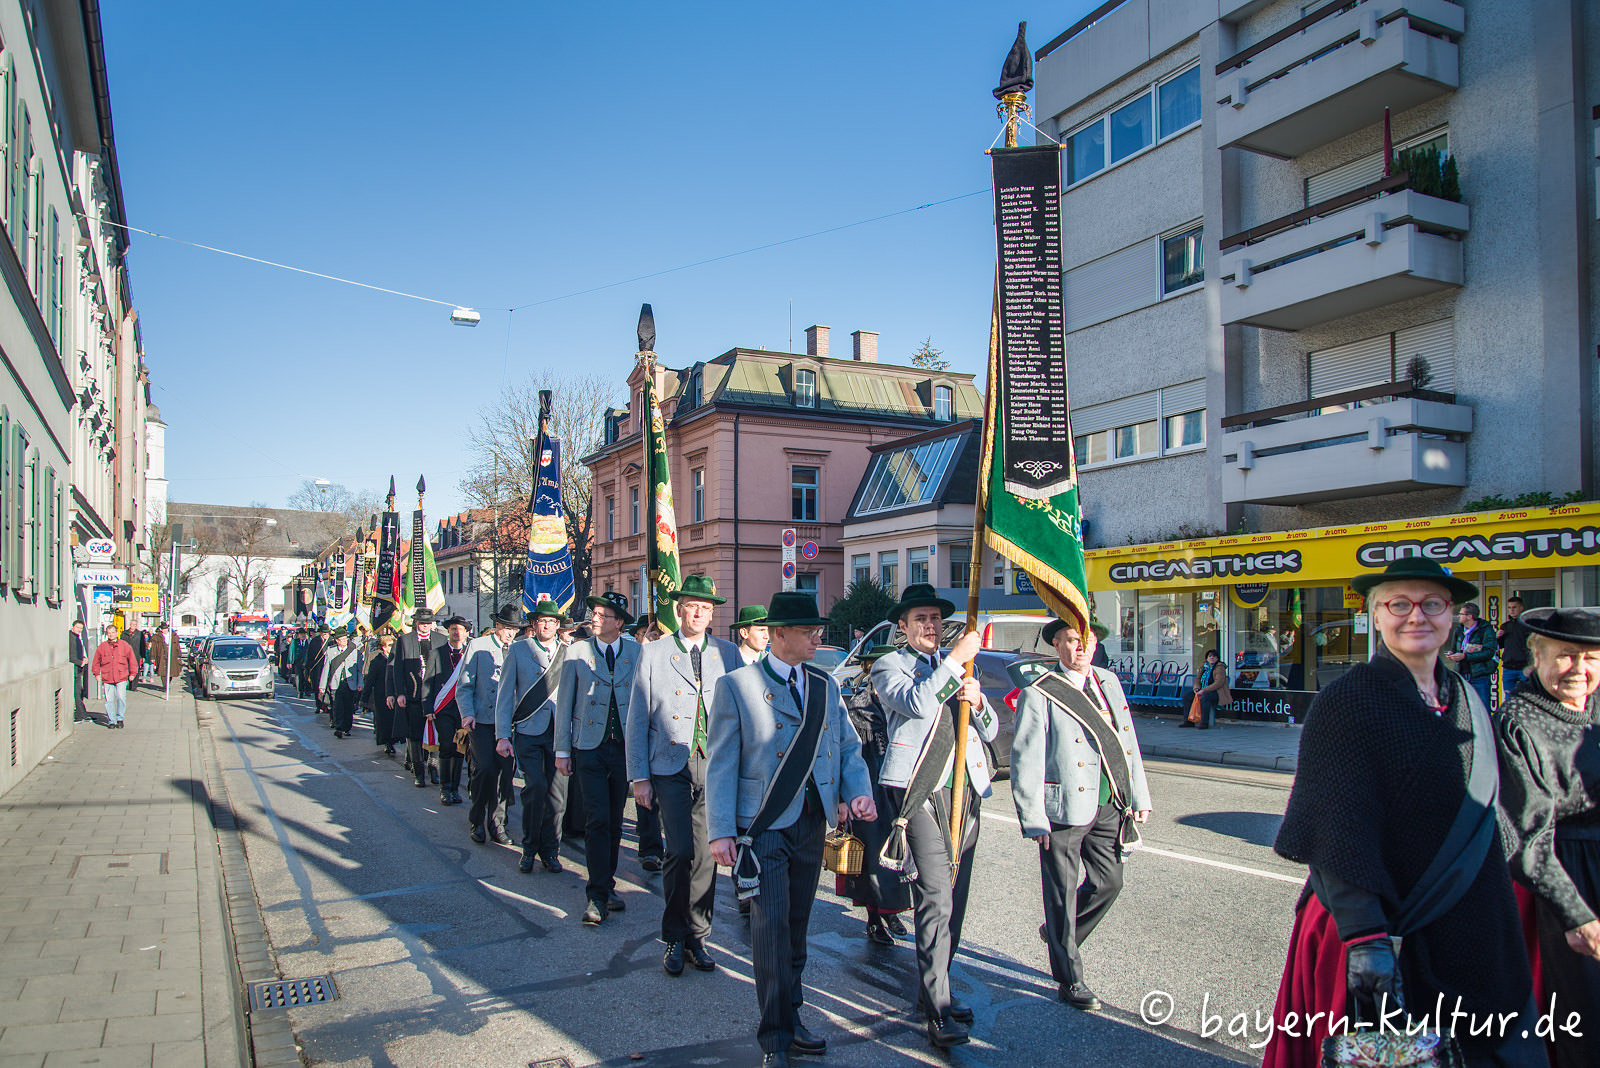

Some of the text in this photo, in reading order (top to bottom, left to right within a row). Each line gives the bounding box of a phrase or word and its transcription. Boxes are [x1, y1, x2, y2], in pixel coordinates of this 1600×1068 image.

[1558, 507, 1580, 515] LOTTO
[1360, 530, 1600, 562] CINEMATH
[114, 588, 130, 598] sky
